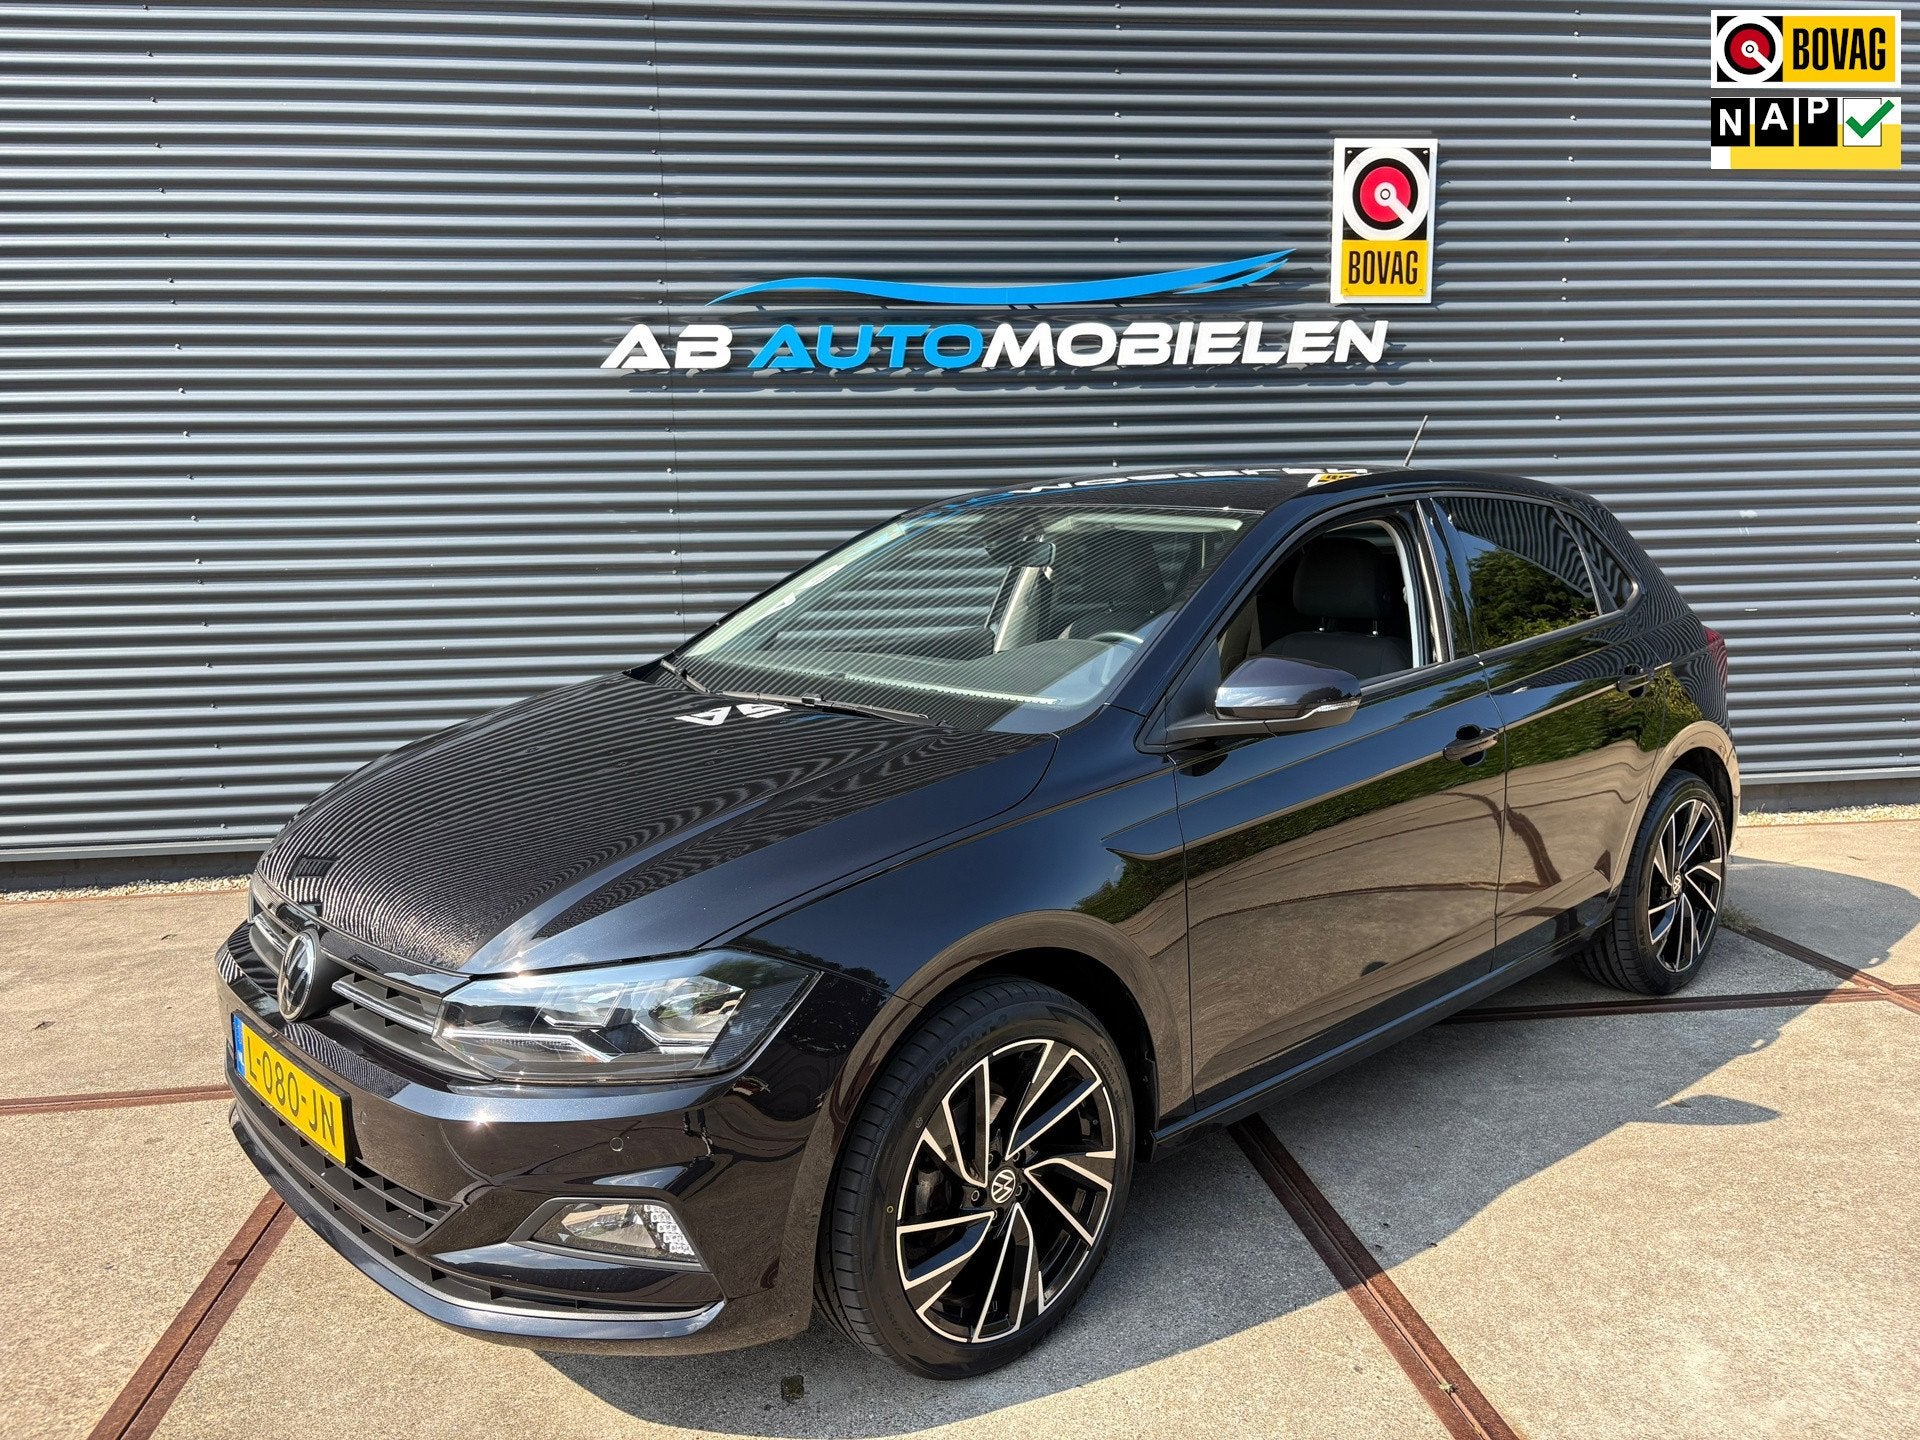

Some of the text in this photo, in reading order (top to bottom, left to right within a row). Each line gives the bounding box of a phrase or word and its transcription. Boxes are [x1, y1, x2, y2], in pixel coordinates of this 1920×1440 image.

[1348, 250, 1418, 285] BOVAG
[600, 320, 1389, 369] AB AUTOMOBIELEN
[246, 1036, 336, 1147] L-080-JN
